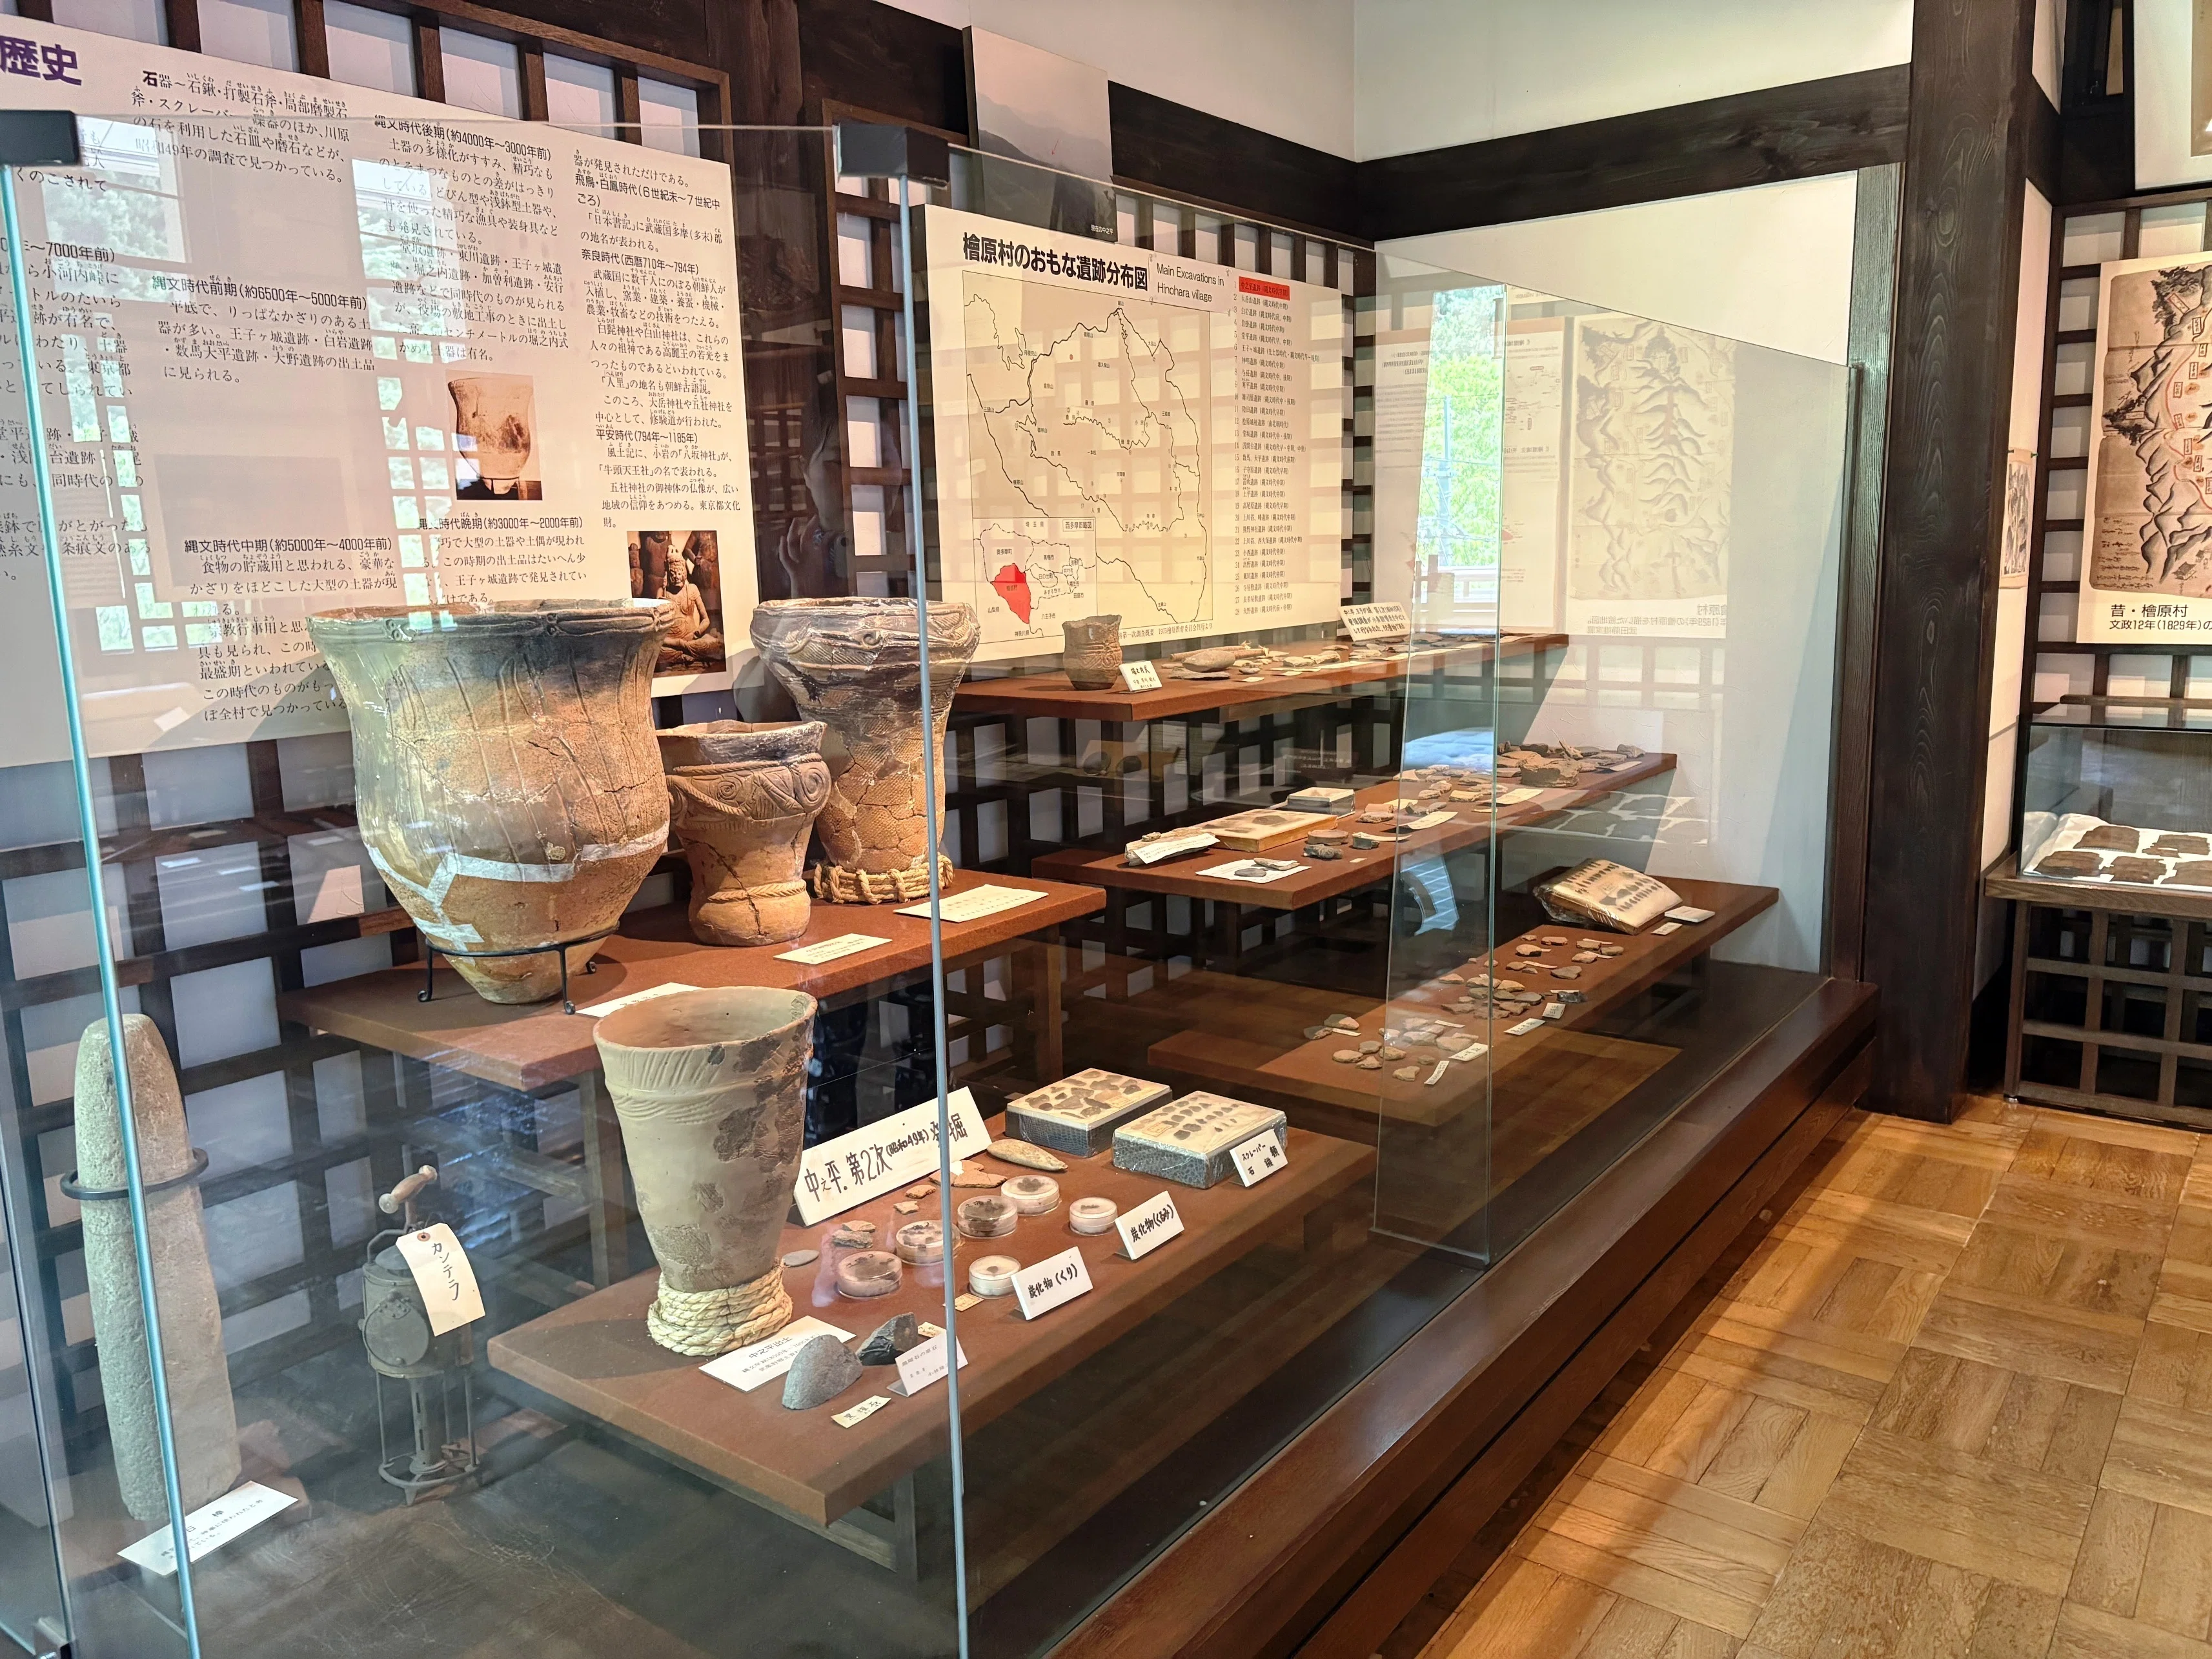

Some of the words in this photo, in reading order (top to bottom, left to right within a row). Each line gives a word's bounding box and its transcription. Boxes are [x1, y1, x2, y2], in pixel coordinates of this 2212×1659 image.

[1, 36, 82, 86] 歴史
[389, 137, 553, 181] 土器の多様化がすすみ、精巧なも
[573, 153, 689, 188] 器が発見されただけである。
[578, 193, 601, 209] ごろ)
[387, 220, 483, 245] も発見されている。
[580, 230, 659, 252] の地名が表われる。
[962, 232, 1149, 292] 檜原村のおもな遺跡分布図
[593, 269, 726, 295] 武蔵国に数千人にのぼる朝鮮人が
[1157, 262, 1175, 277] Main
[1176, 266, 1215, 285] Excavations
[1215, 276, 1224, 287] in
[392, 280, 565, 312] 遺跡などで同時代のものが見られる
[1157, 281, 1190, 299] Hinohara
[1192, 287, 1213, 303] village
[394, 301, 567, 331] が、役場の敷地工事のときに出土し
[586, 303, 720, 329] 農業・牧畜などの技術をつたえる。
[590, 340, 730, 363] 人々の祖神である高麗王の若光をま
[164, 366, 241, 384] に見られる。
[591, 359, 727, 380] つったものであるといわれている。
[604, 394, 733, 413] このころ、大岳神社や五社神社を
[595, 411, 722, 429] 中心として、修験道が行われた。
[607, 447, 733, 462] 風土記に、小岩の「八坂神社」が、
[599, 463, 718, 478] 「牛頭天王社」の名で表われる。
[609, 482, 739, 494] 五社神社の御神体の仏像が、広い
[602, 499, 741, 511] 地域の信仰をあつめる。東京都文化
[603, 517, 617, 528] 財。
[202, 558, 394, 575] 食物の貯蔵用と思われる、豪華な
[190, 576, 398, 596] かざりをほどこした大型の土器が現
[2110, 604, 2189, 618] 昔・檜原村
[2109, 619, 2212, 631] 文政12年(1829年)の
[1130, 1203, 1174, 1243] 炭化物(くるみ)
[431, 1241, 460, 1302] カンテラ
[1028, 1263, 1078, 1299] 炭化物(くり)
